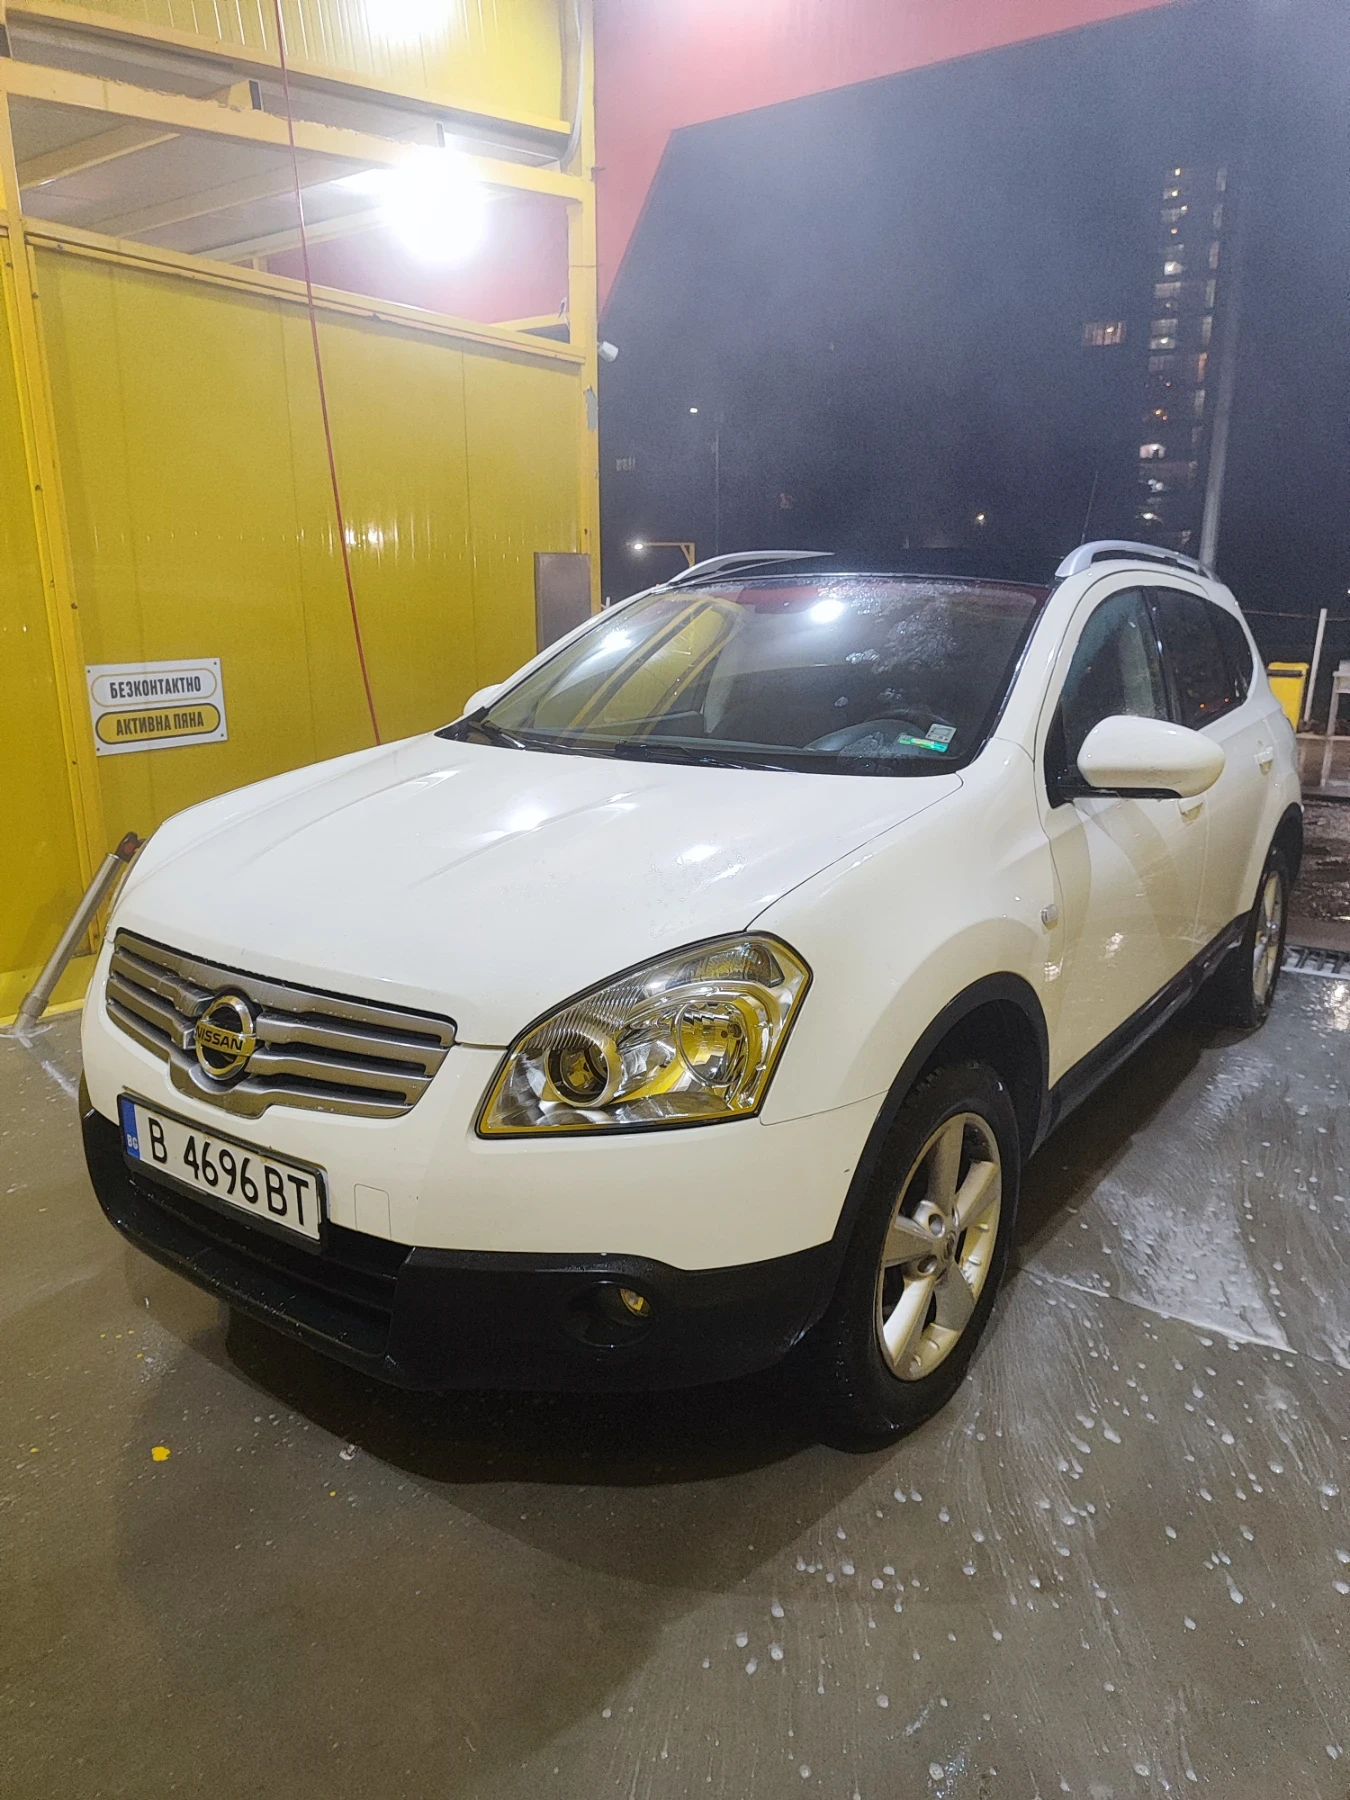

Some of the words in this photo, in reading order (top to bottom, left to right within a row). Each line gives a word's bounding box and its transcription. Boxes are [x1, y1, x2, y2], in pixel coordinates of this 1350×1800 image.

[109, 676, 201, 699] БЕЗКОНТАКТНО
[116, 714, 172, 736] АКТИВНА
[173, 711, 204, 730] ПЯНА
[196, 1025, 243, 1051] NISSAN
